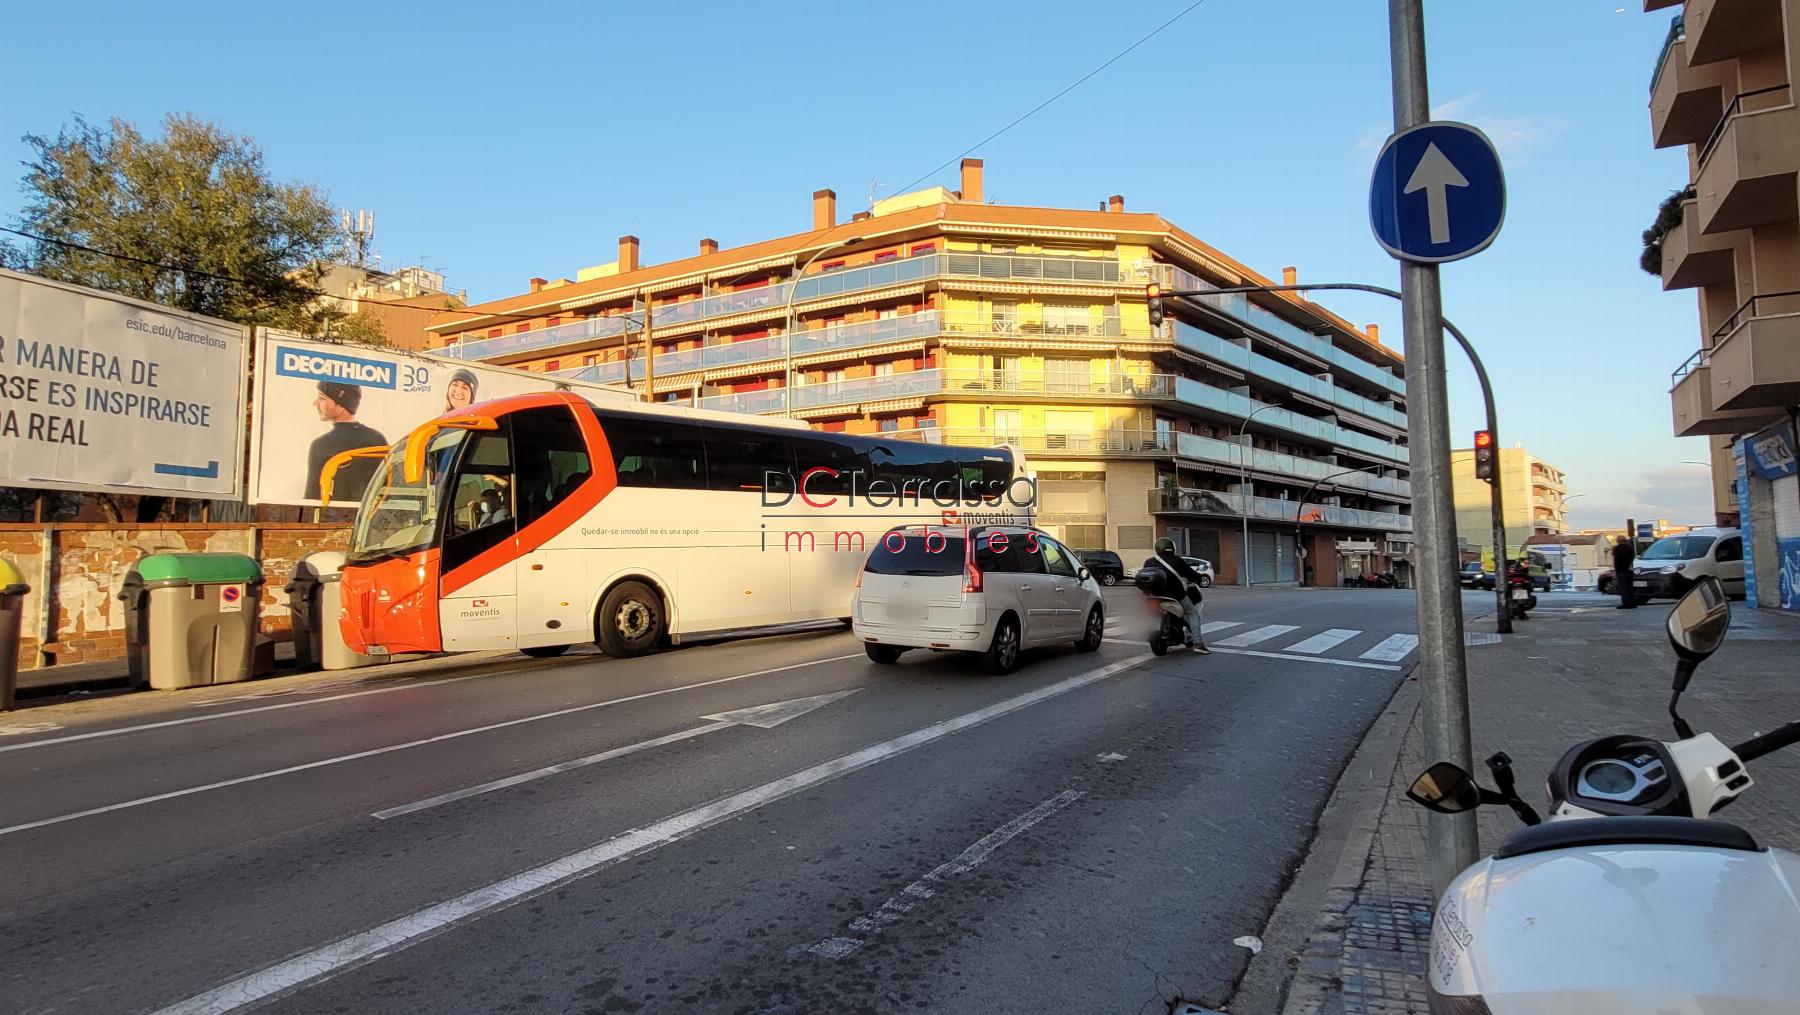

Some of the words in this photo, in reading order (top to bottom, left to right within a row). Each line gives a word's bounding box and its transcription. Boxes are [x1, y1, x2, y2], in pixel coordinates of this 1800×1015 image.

[126, 318, 227, 350] esic.edu/barcelona
[16, 338, 122, 382] MANERA
[131, 359, 159, 388] DE
[283, 353, 391, 384] DECATHLON
[47, 381, 77, 408] ES
[85, 387, 211, 428] INSPIRARSE
[28, 412, 89, 446] REAL
[581, 527, 619, 536] Quedar-se
[963, 508, 1015, 525] moventis
[460, 608, 500, 617] moventis
